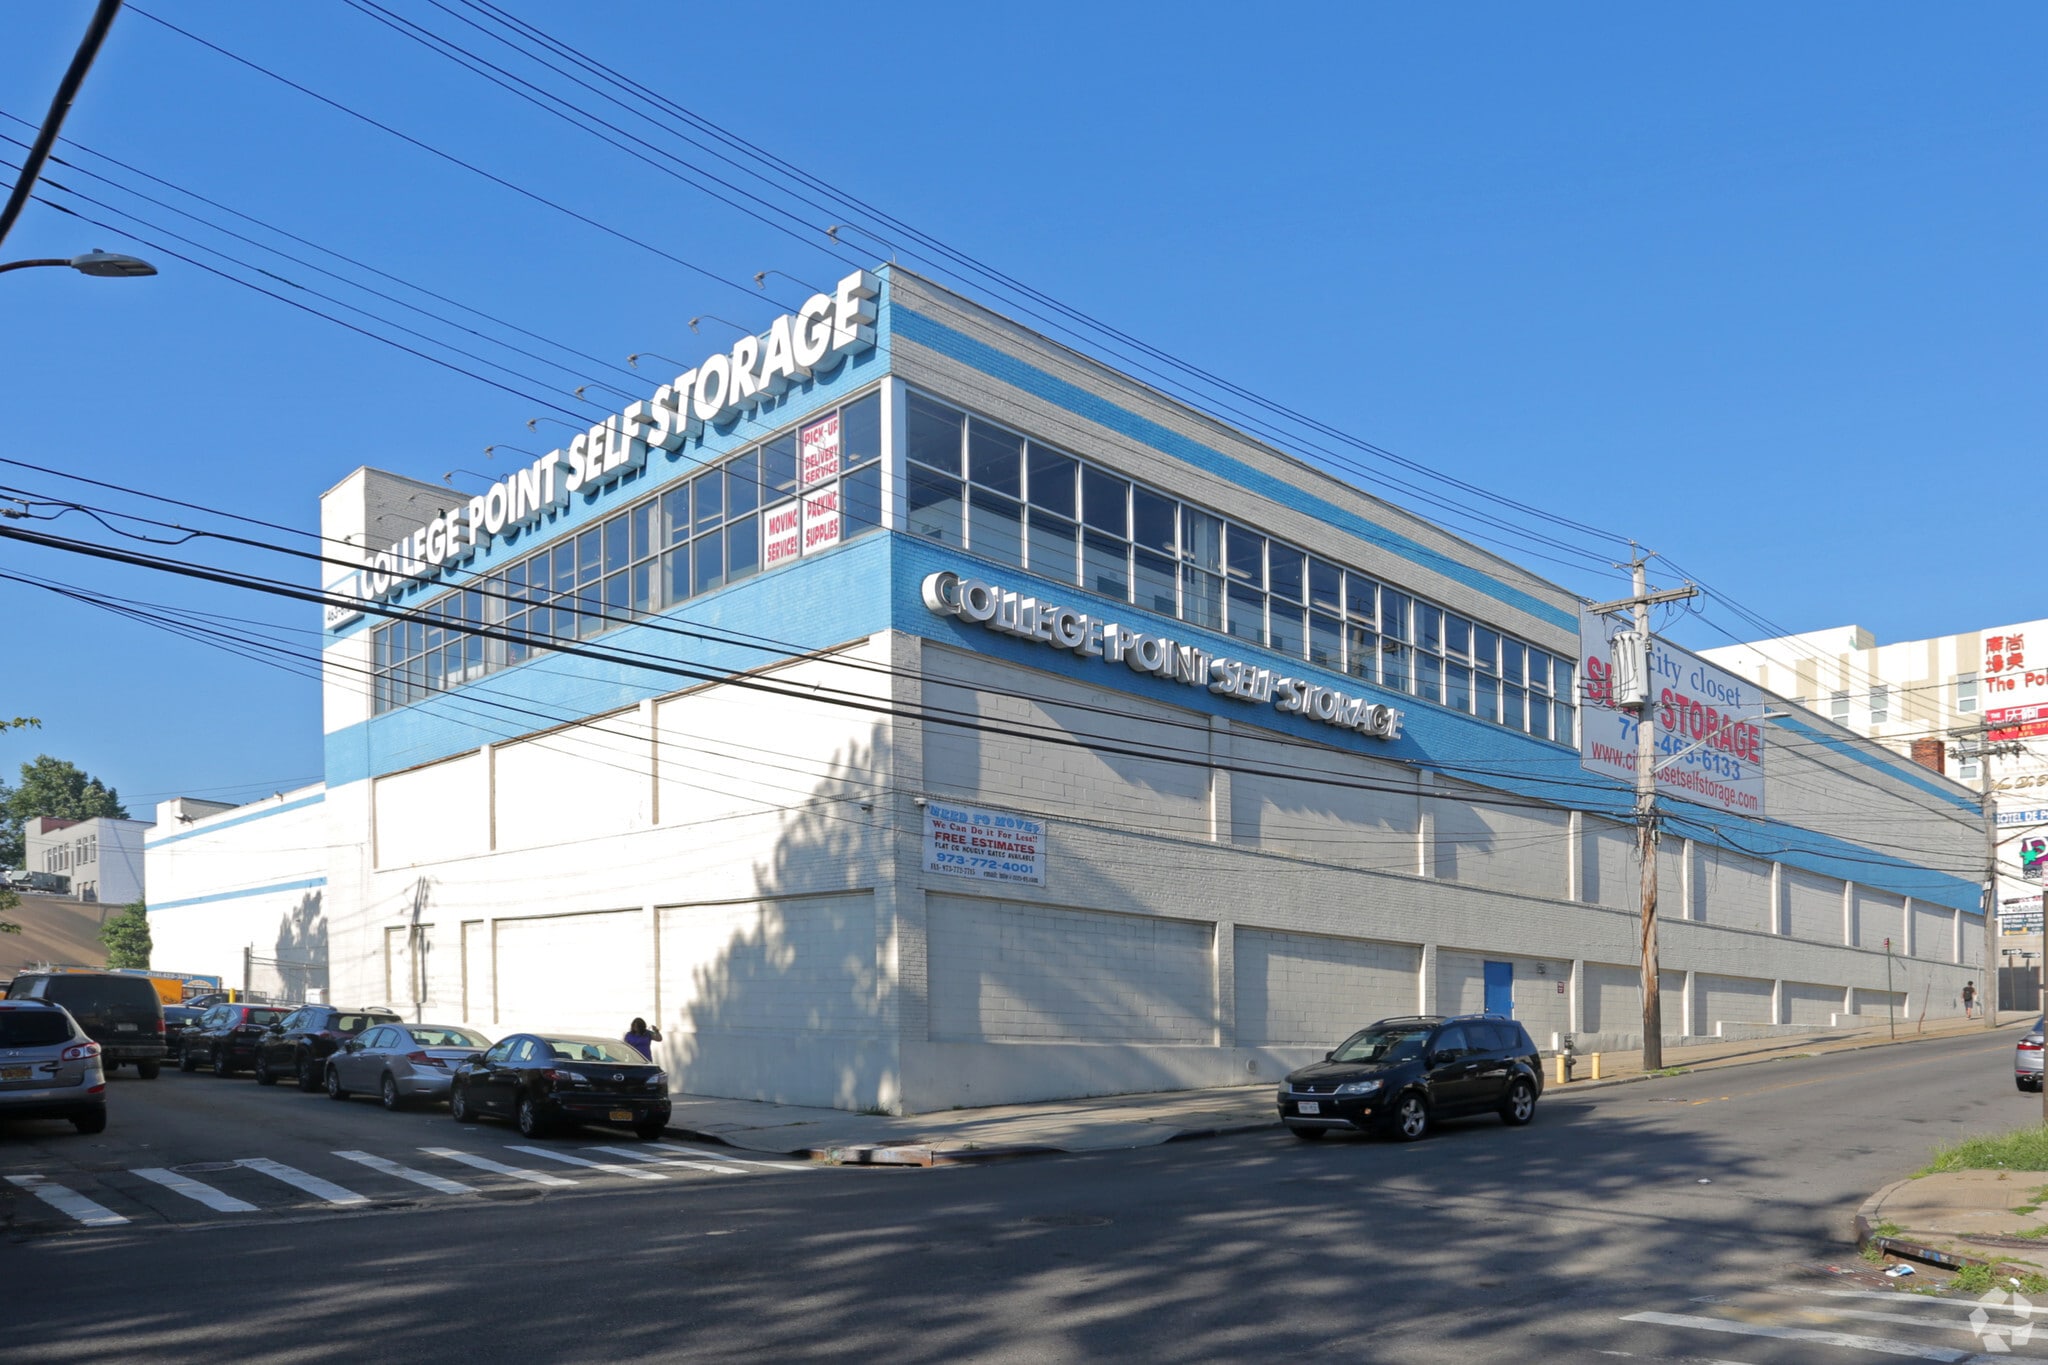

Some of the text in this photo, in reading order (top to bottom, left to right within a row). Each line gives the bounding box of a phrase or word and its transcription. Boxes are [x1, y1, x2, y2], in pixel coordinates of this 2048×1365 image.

[361, 270, 866, 600] COLLEGE POINT SELF STORAGE
[804, 419, 838, 447] PICK-UP
[805, 445, 838, 470] DELIVERY
[805, 460, 838, 484] SERVICE
[807, 490, 837, 521] PACKING
[769, 510, 798, 536] MOVING
[806, 518, 838, 548] SUPPLIES
[767, 535, 798, 563] SERVICES
[922, 571, 1405, 740] COLLEGE POINT SELF STORAGE
[1690, 666, 1741, 709] closet
[1985, 676, 2015, 693] The
[1661, 688, 1760, 766] STORAGE
[930, 805, 1040, 834] NEED TO MOVE?
[932, 820, 946, 829] We
[950, 823, 967, 833] Can
[971, 826, 982, 835] Do
[998, 830, 1012, 840] For
[1016, 833, 1038, 843] Less!!
[934, 842, 949, 850] FLAT
[962, 846, 985, 856] HOURLY
[988, 850, 1006, 858] RATES
[1008, 852, 1035, 863] AVAILABLE
[935, 831, 1035, 854] FREE ESTIMATES
[936, 853, 1033, 873] 973-772-4001
